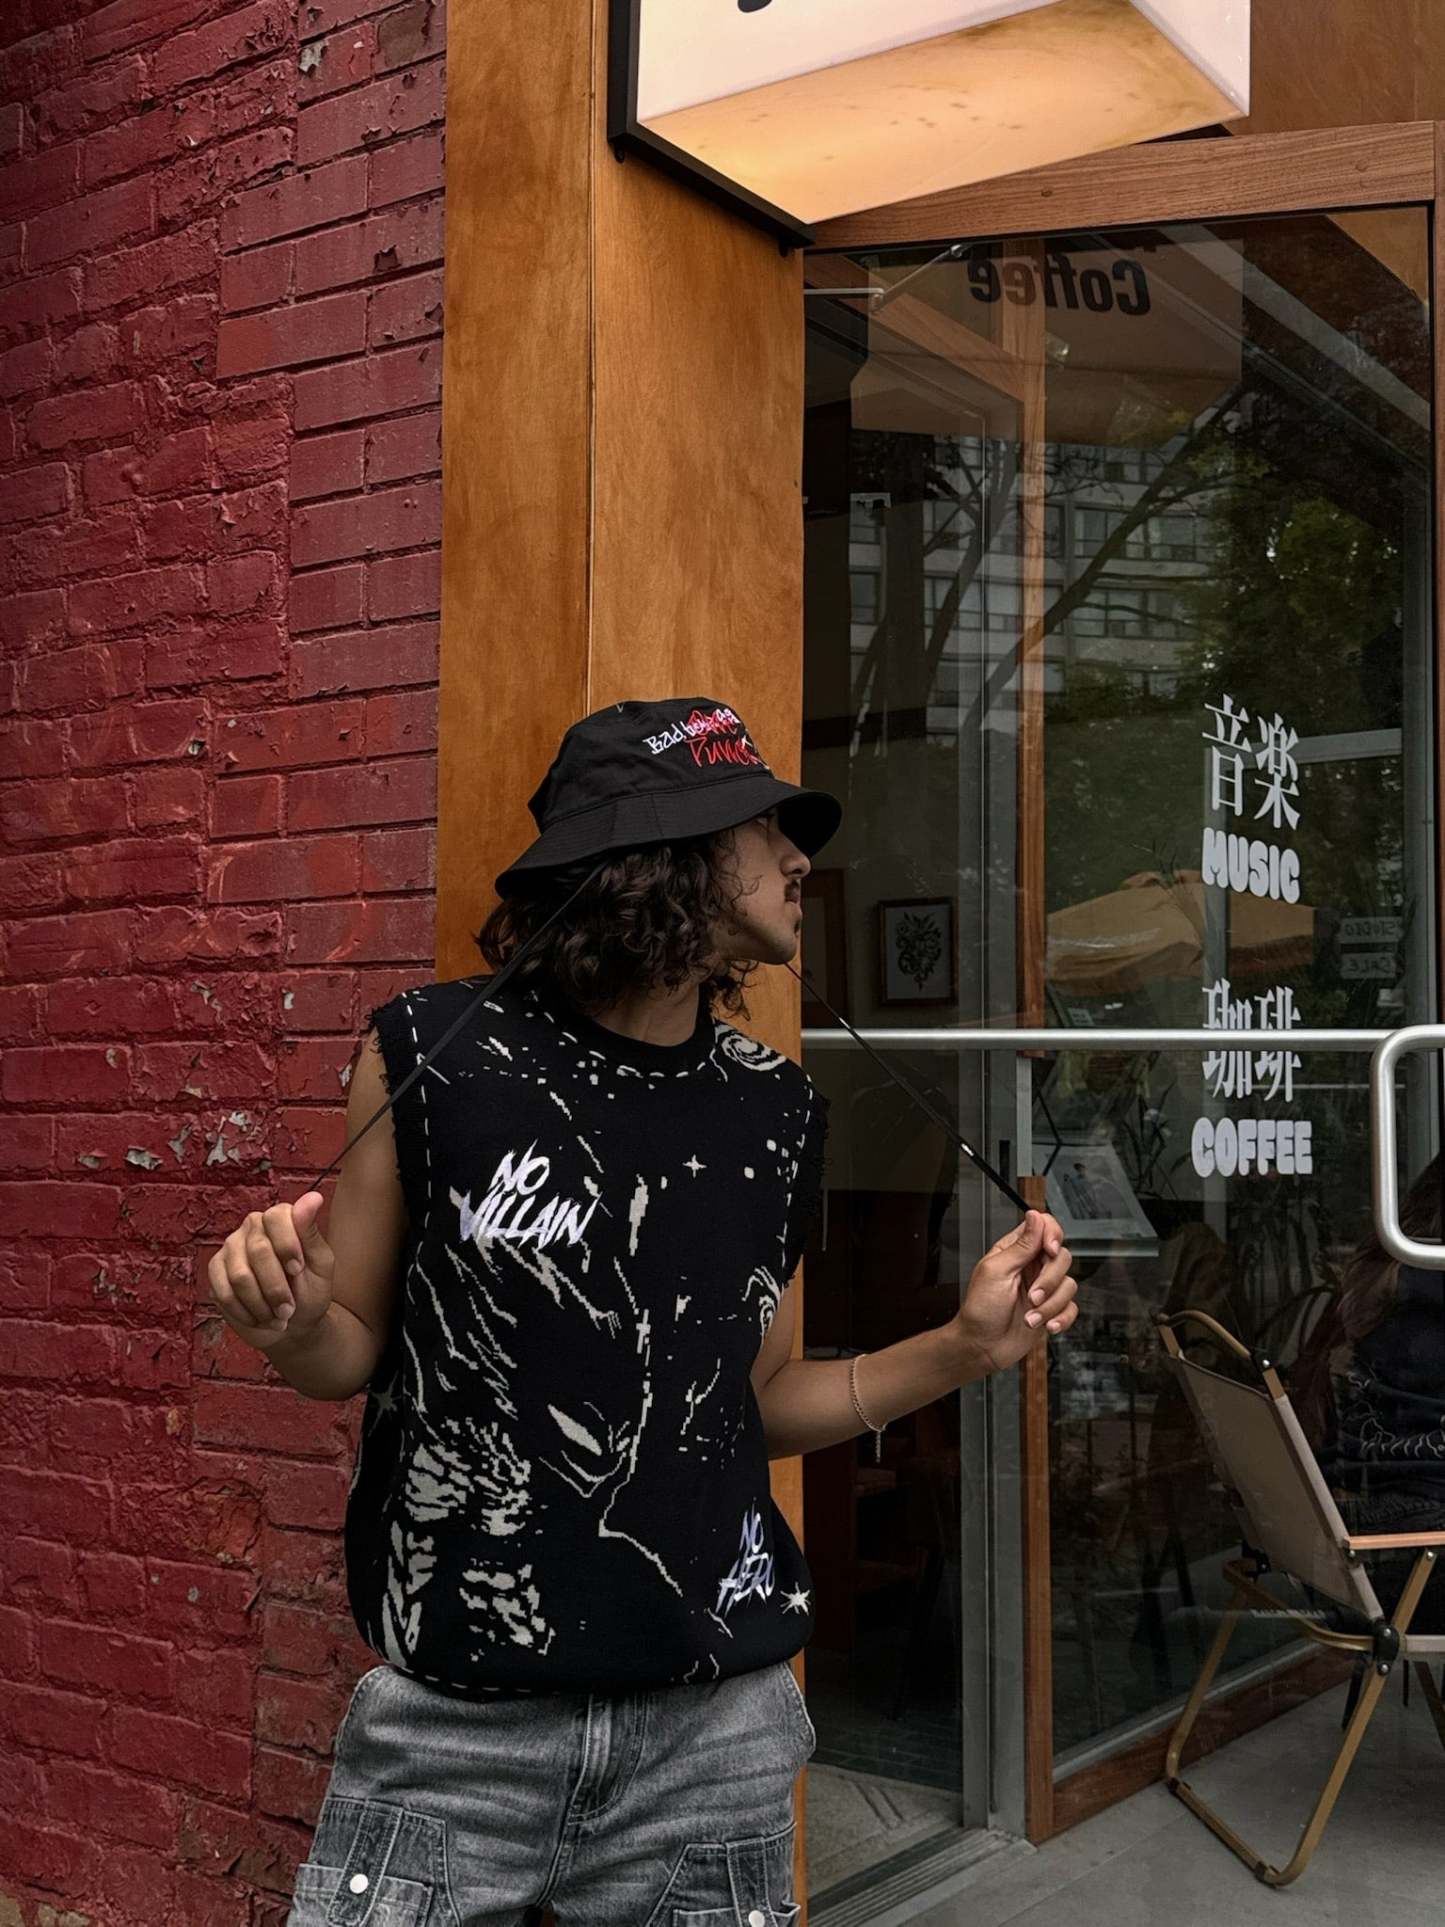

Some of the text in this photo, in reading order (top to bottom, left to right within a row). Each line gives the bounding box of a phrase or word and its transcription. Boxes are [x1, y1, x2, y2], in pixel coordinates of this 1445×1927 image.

[1202, 693, 1301, 831] 音楽
[1202, 826, 1301, 905] MUSIC
[487, 1138, 550, 1195] NO
[1191, 1117, 1313, 1178] COFFEE
[450, 1188, 603, 1250] VILLAIN
[739, 1504, 764, 1554] NO
